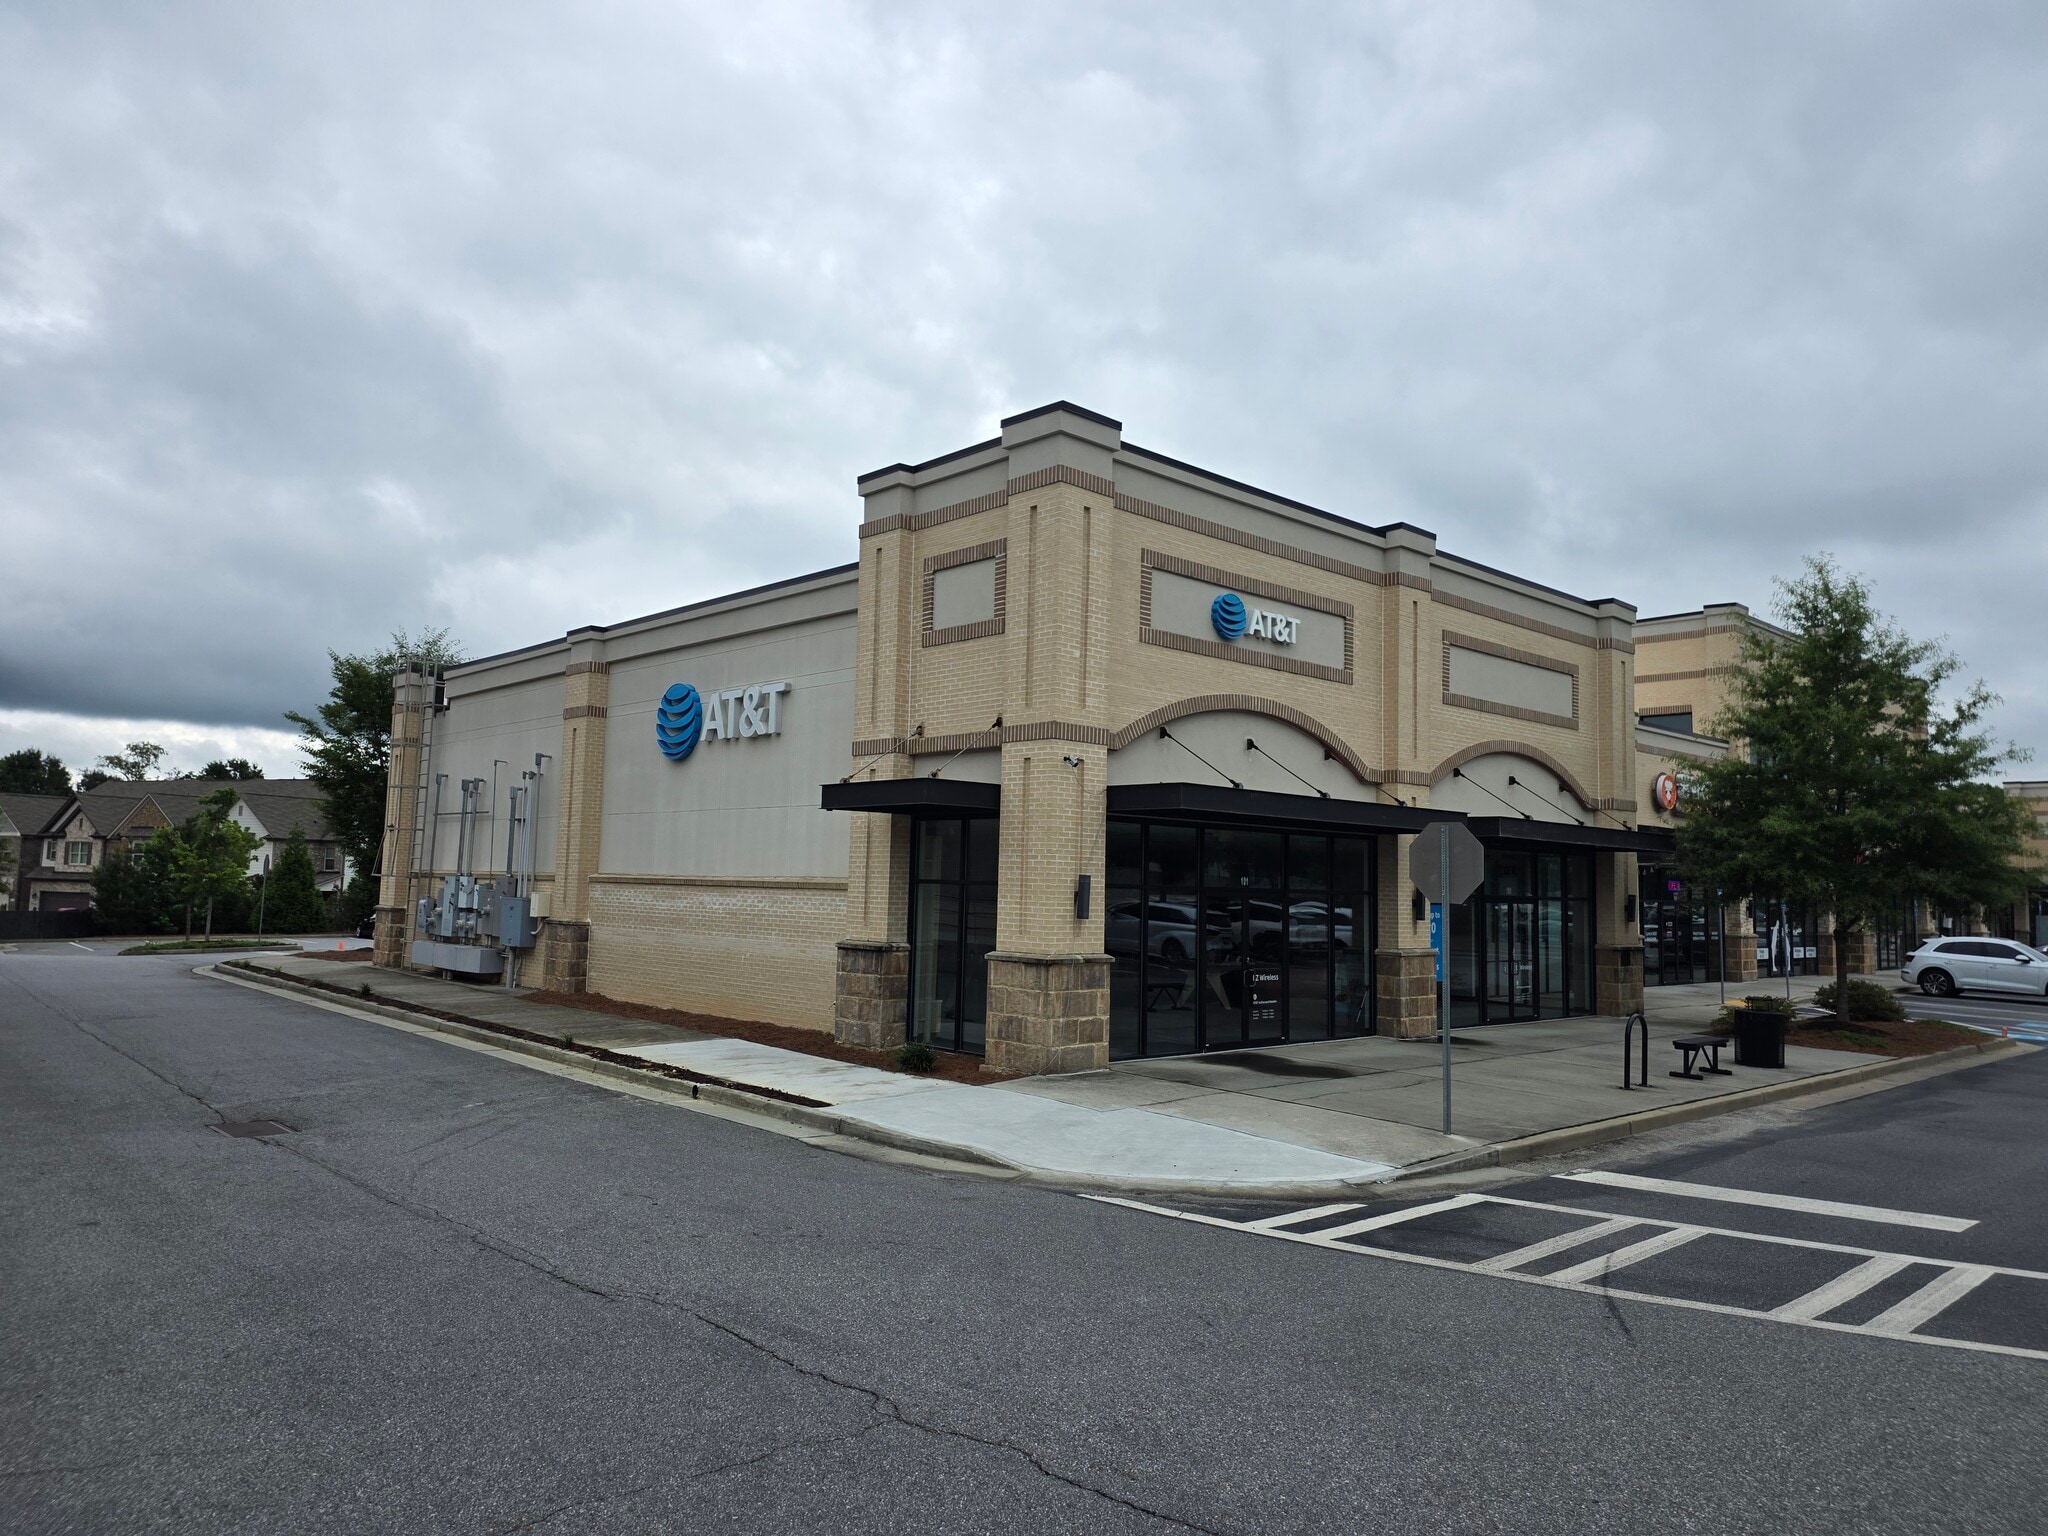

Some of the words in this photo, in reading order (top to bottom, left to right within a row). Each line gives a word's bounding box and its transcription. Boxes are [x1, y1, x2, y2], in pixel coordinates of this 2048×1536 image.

[1247, 608, 1302, 645] AT&T
[700, 680, 792, 742] AT&T
[1259, 973, 1279, 982] Wireless
